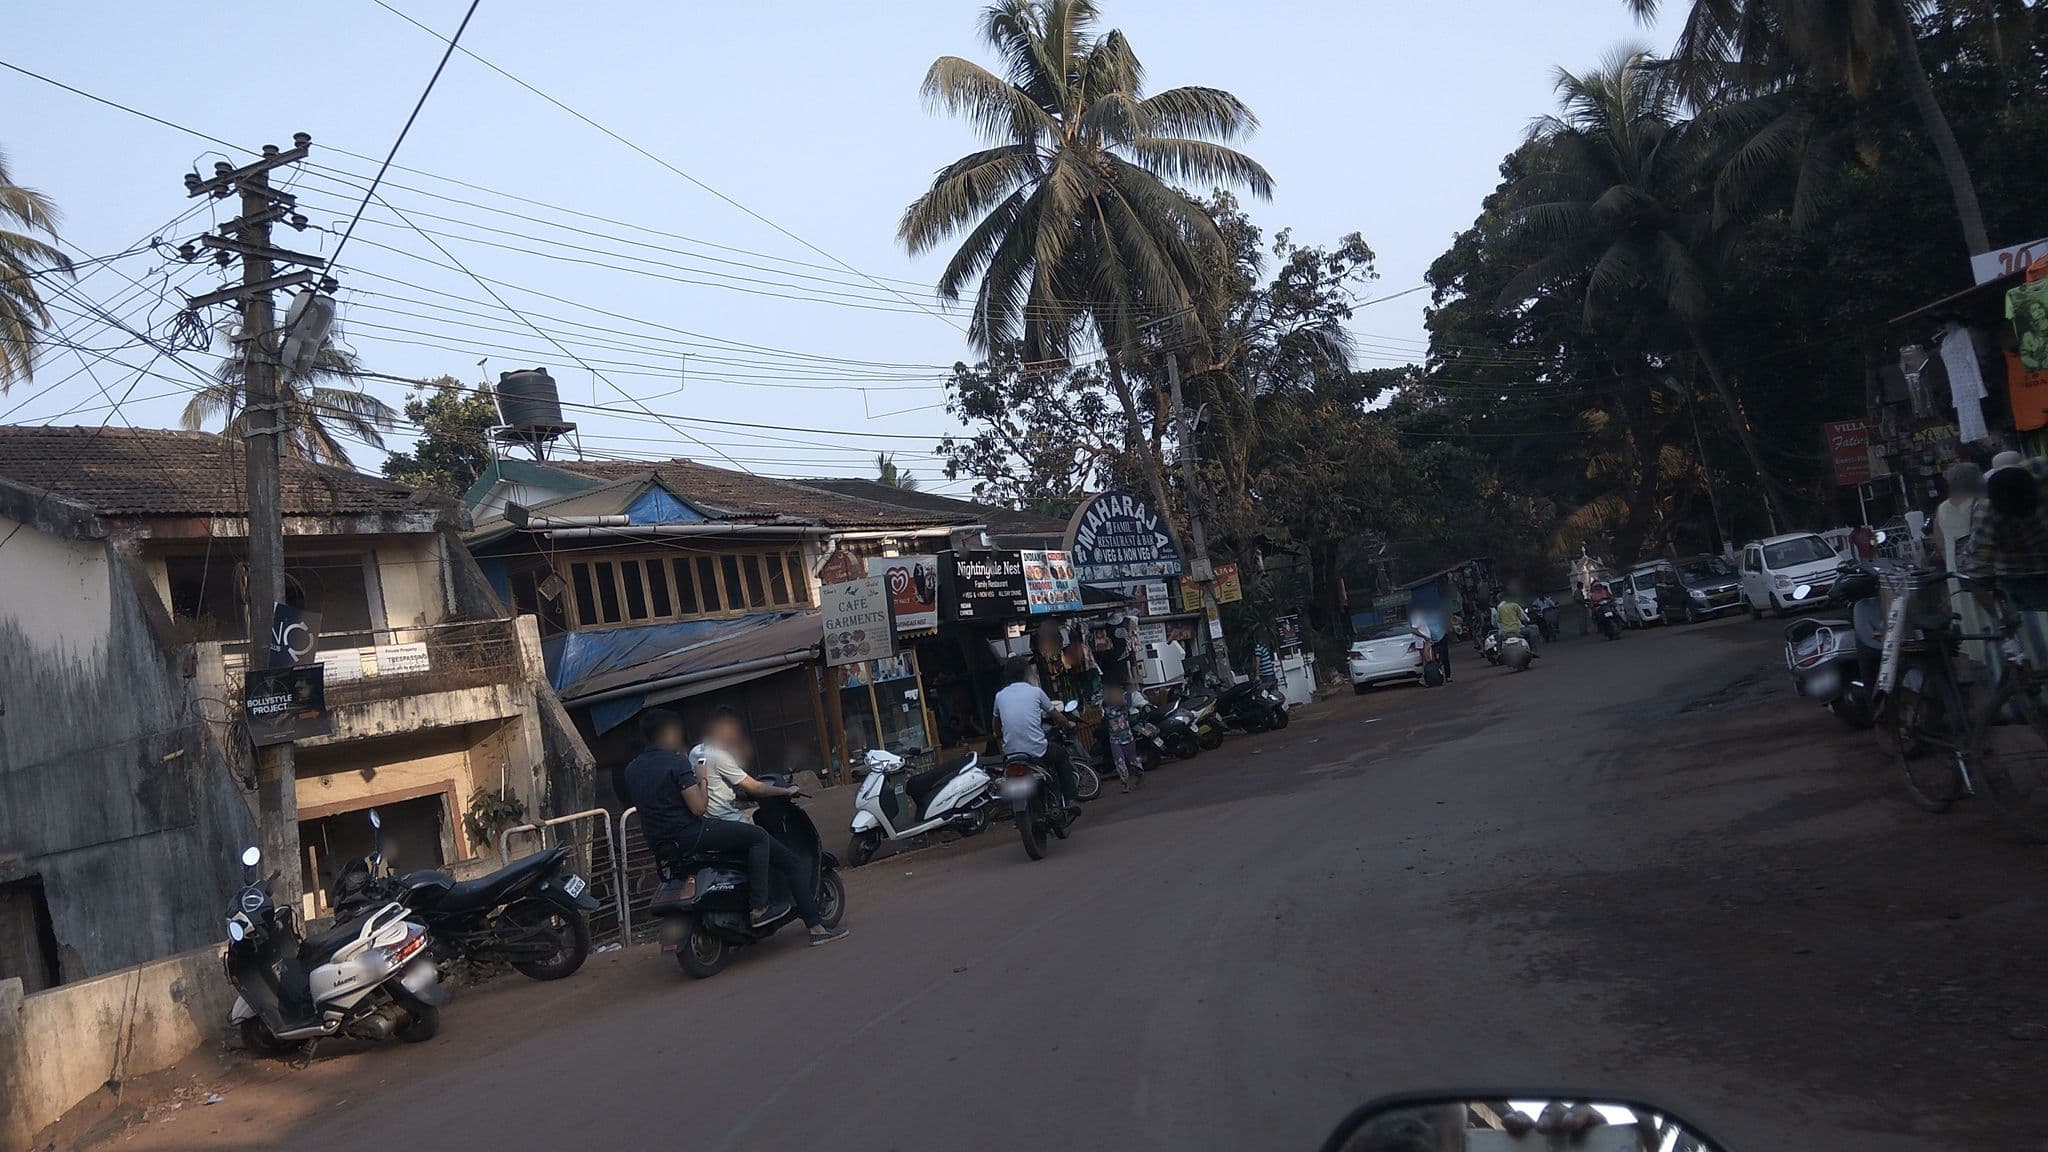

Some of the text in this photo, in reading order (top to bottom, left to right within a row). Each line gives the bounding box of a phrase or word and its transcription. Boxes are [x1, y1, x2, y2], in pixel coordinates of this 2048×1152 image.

[1833, 422, 1866, 433] VILLA
[1077, 495, 1169, 552] MAHARAJA
[1113, 521, 1136, 533] FAMIL
[1097, 534, 1136, 548] RESTAURANT
[1142, 534, 1155, 547] BAR
[1102, 548, 1117, 562] VEG
[1117, 549, 1123, 561] &
[1123, 548, 1138, 562] NON
[1137, 547, 1151, 560] VEG
[1003, 561, 1021, 575] Nest
[825, 611, 885, 630] GARMENTS
[246, 693, 293, 709] BOLLYSTYLE
[252, 703, 289, 716] PROJECT
